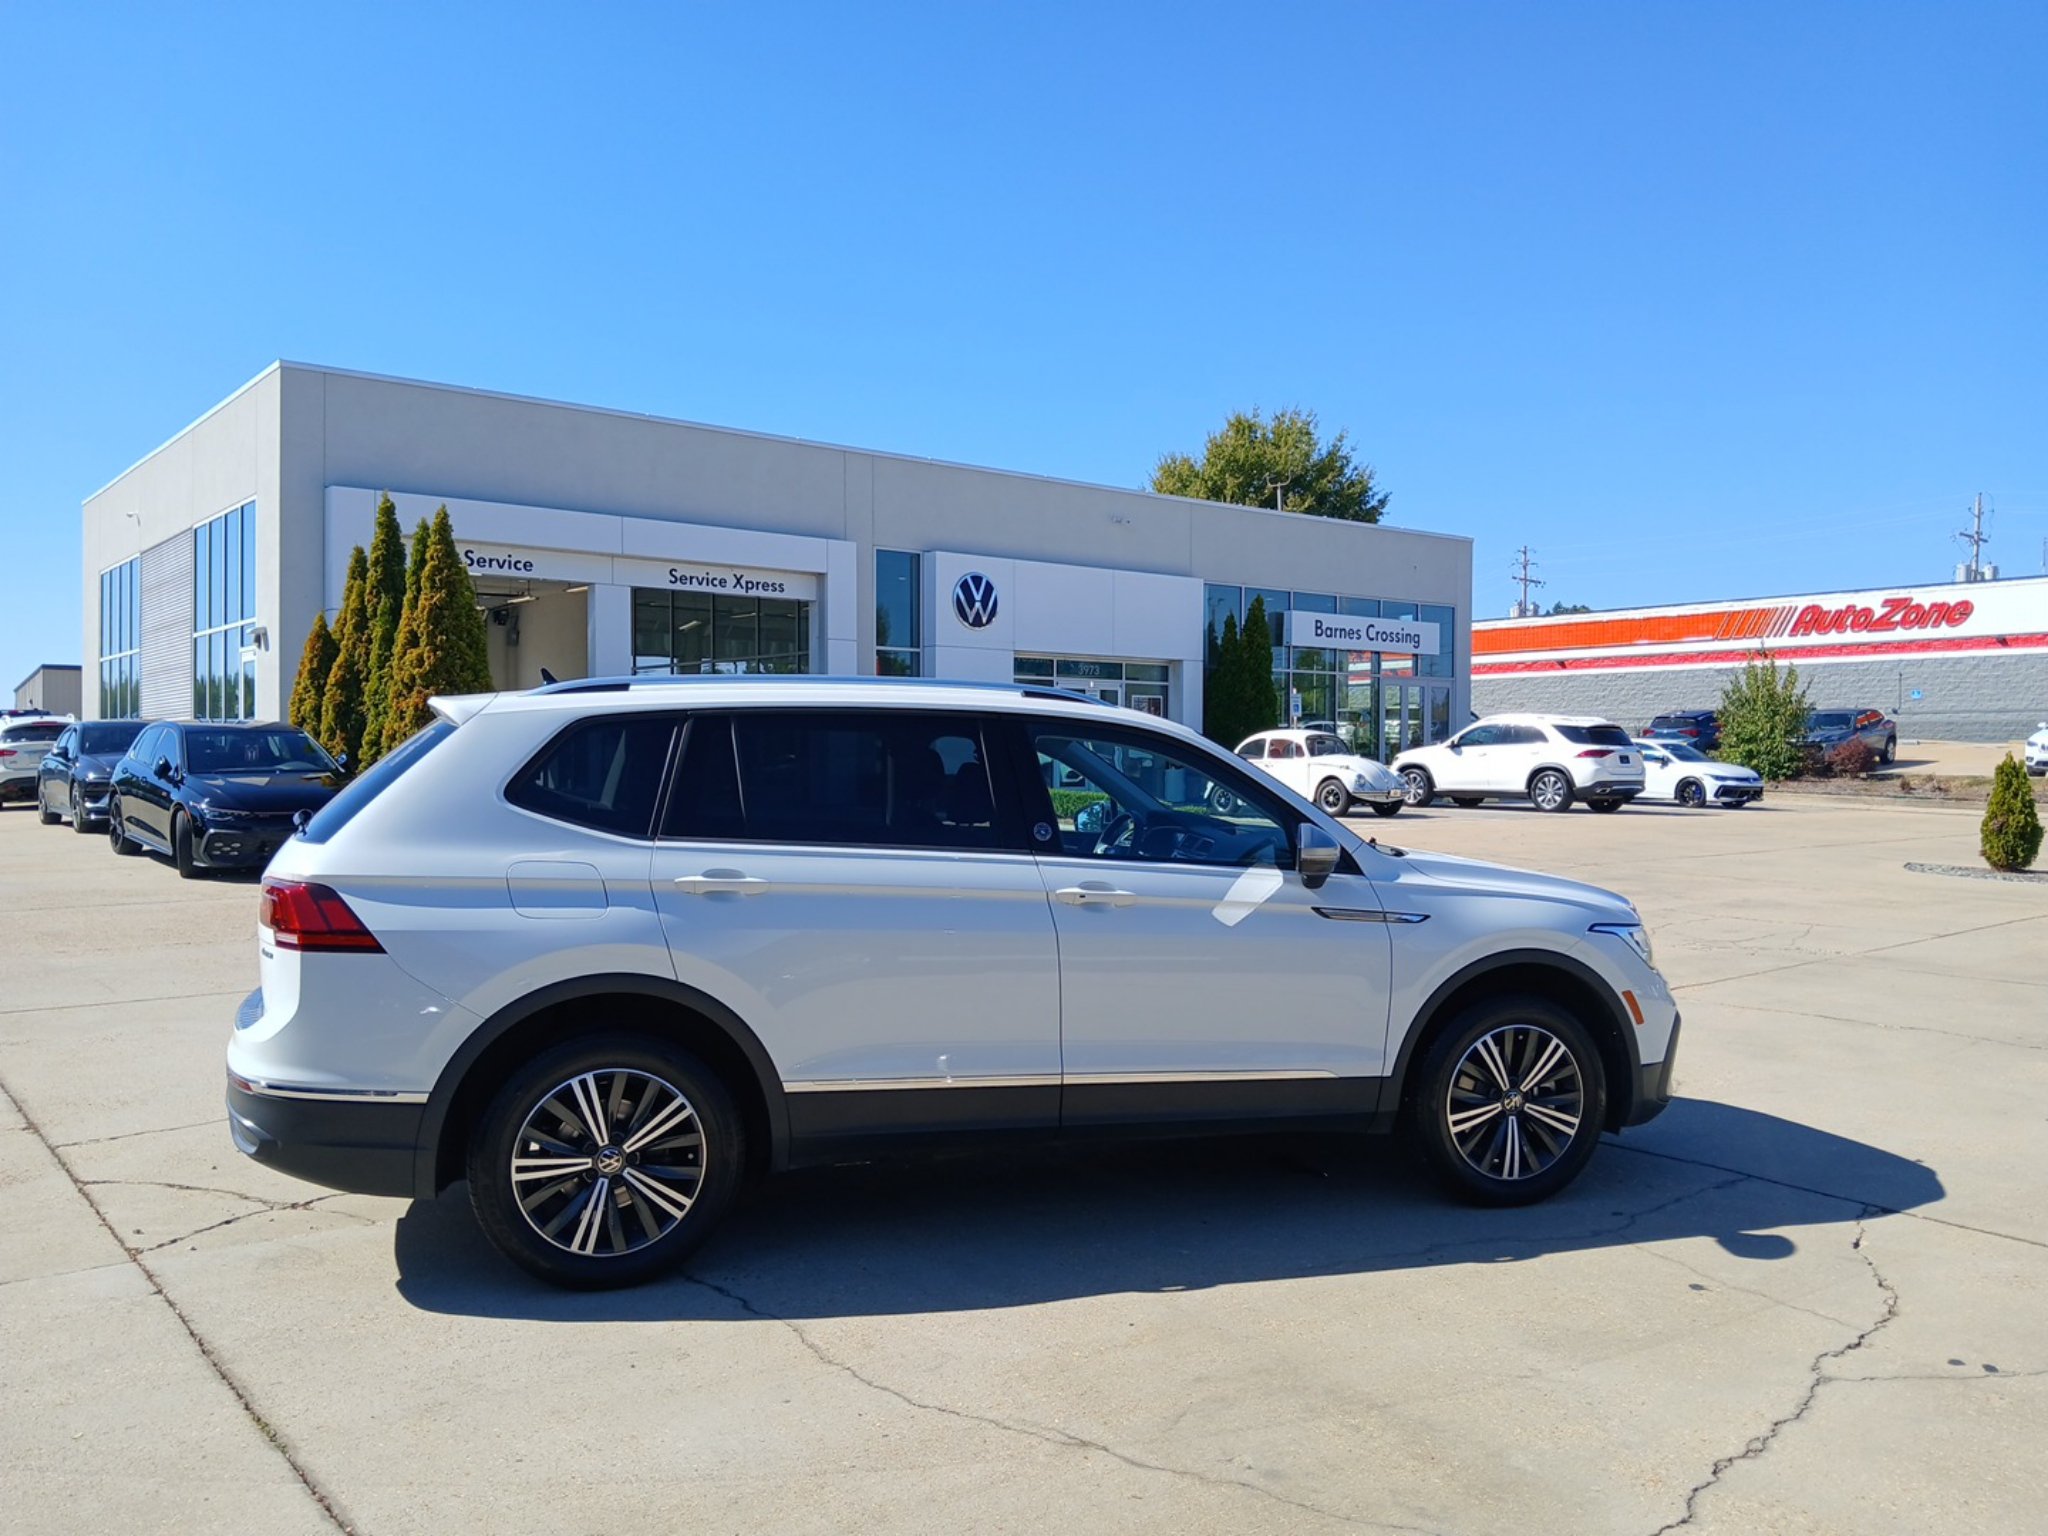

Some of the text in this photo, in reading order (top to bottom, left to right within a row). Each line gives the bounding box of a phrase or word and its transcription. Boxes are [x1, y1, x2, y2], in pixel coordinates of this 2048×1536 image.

[464, 549, 534, 572] Service
[669, 568, 785, 593] Service Xpress
[1788, 597, 1974, 637] AutoZone
[1314, 619, 1421, 649] Barnes Crossing
[1078, 664, 1100, 675] 3973
